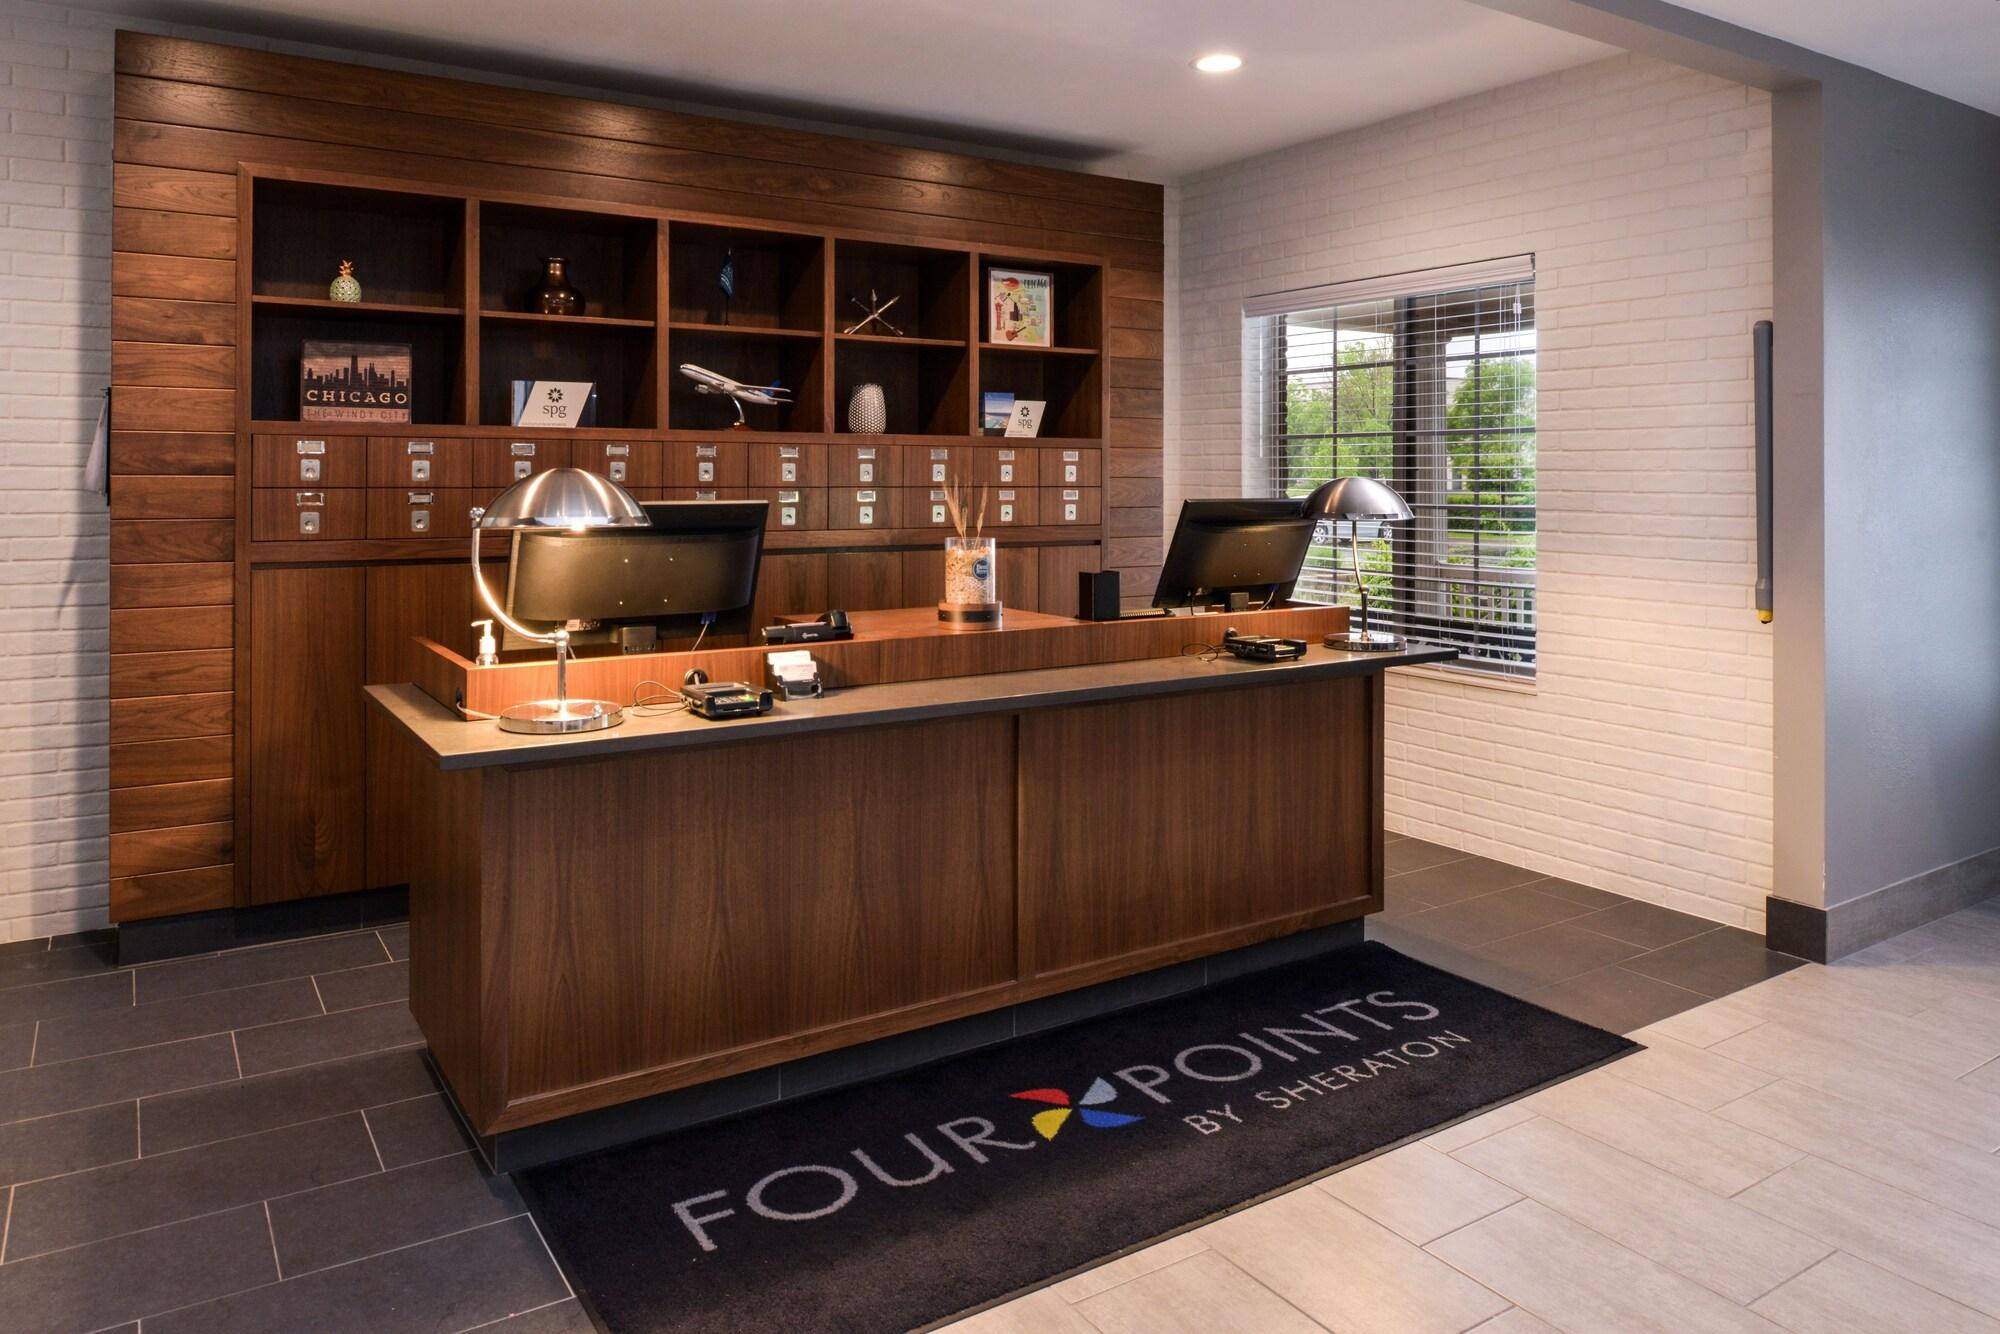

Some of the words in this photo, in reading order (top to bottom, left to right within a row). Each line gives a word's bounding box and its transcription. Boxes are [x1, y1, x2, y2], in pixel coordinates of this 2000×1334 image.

[306, 389, 407, 404] CHICAGO
[306, 408, 327, 418] THE
[336, 408, 373, 419] WINDY
[381, 410, 406, 419] CITY
[542, 404, 567, 418] spg
[1017, 419, 1033, 429] spg
[1181, 1103, 1244, 1136] BY
[1254, 1029, 1473, 1110] SHERATON
[671, 1116, 1037, 1252] FOUR
[1112, 990, 1440, 1105] POINTS
